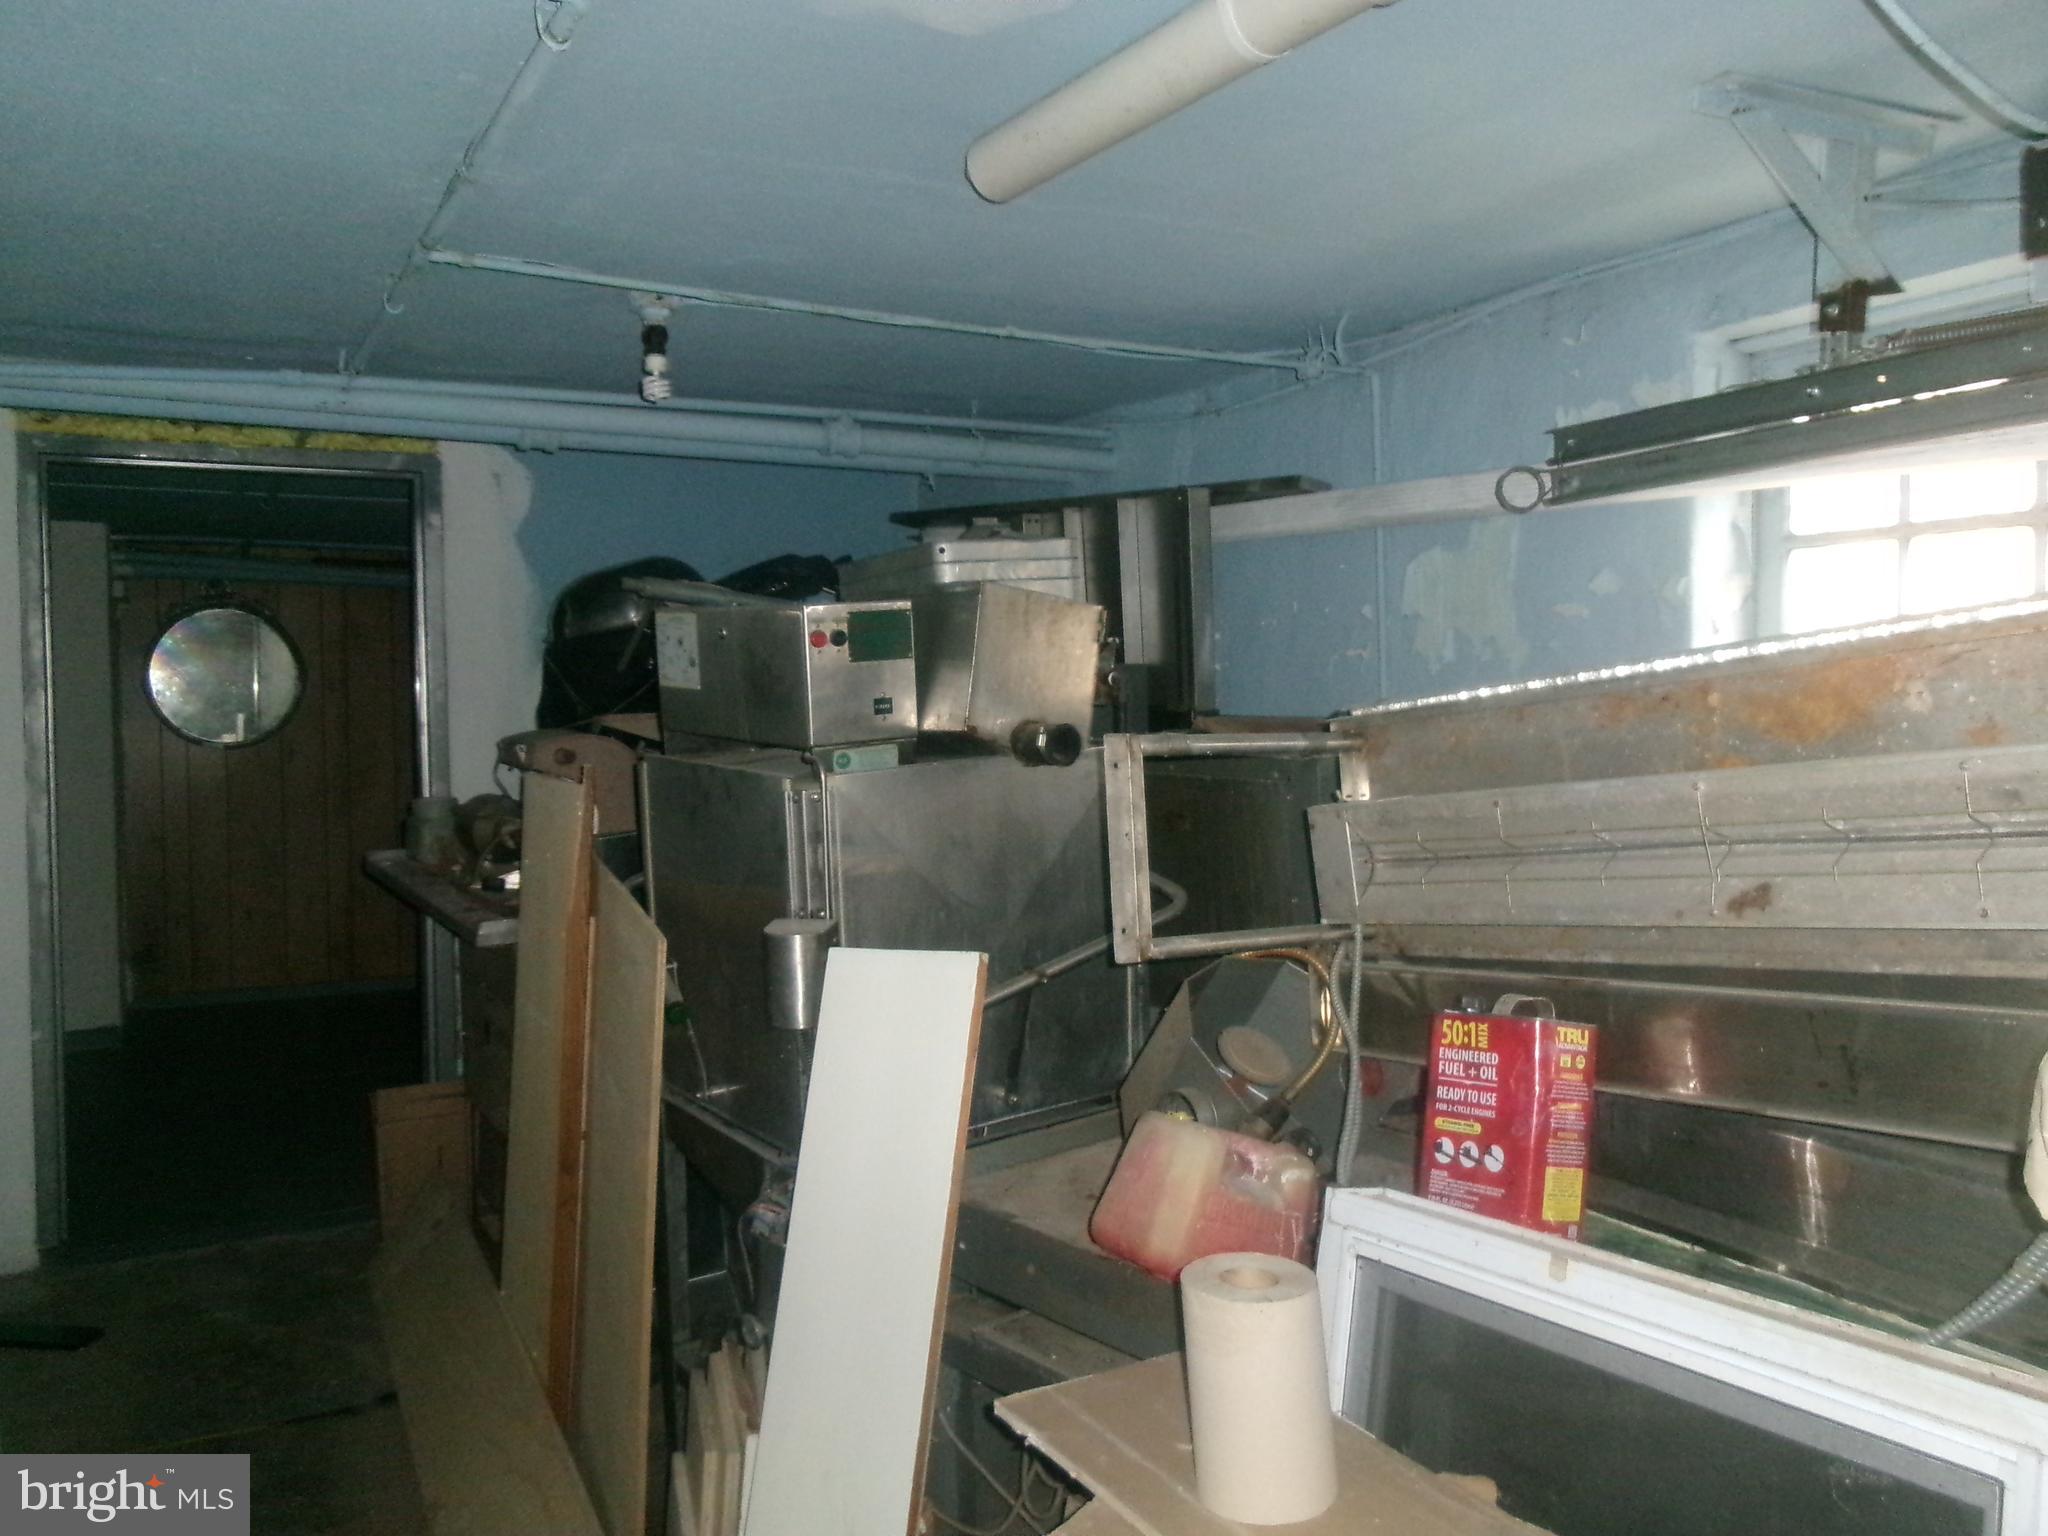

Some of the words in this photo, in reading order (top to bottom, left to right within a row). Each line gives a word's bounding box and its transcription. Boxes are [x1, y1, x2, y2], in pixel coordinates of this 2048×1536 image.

[1441, 1019, 1476, 1047] 50:1
[1477, 1022, 1489, 1049] MIX
[1557, 1026, 1589, 1046] TRU
[1439, 1046, 1499, 1065] ENGINEERED
[1438, 1060, 1466, 1077] FUEL
[1468, 1066, 1478, 1078] +
[1480, 1065, 1499, 1081] OIL
[1436, 1085, 1466, 1101] READY
[1467, 1089, 1479, 1103] TO
[1480, 1091, 1497, 1106] USE
[1447, 1104, 1471, 1115] 2-CYCLE
